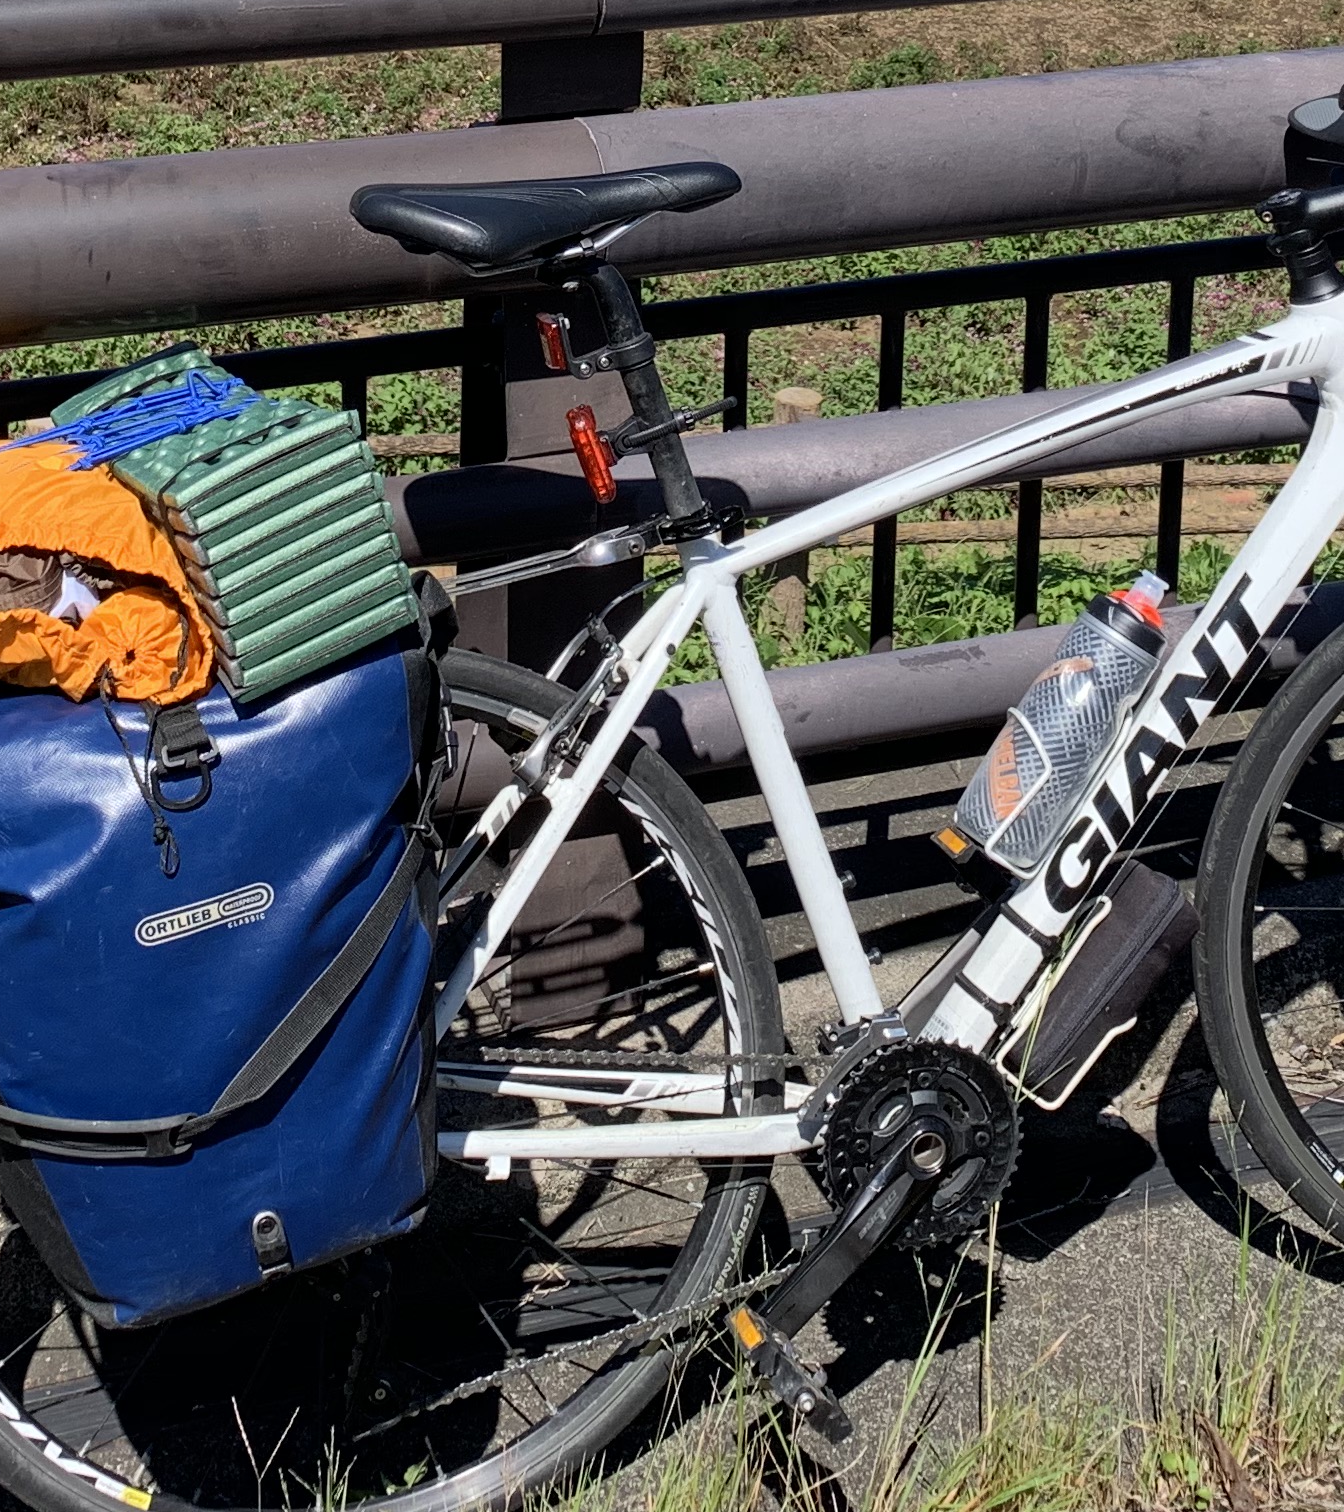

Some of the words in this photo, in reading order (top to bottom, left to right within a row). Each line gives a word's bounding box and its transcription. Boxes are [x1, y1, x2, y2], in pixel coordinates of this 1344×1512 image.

[1044, 571, 1261, 914] GIANT
[144, 908, 212, 937] ORTLIEB
[224, 894, 263, 911] WATERPROOF
[227, 912, 265, 929] CLASSIC
